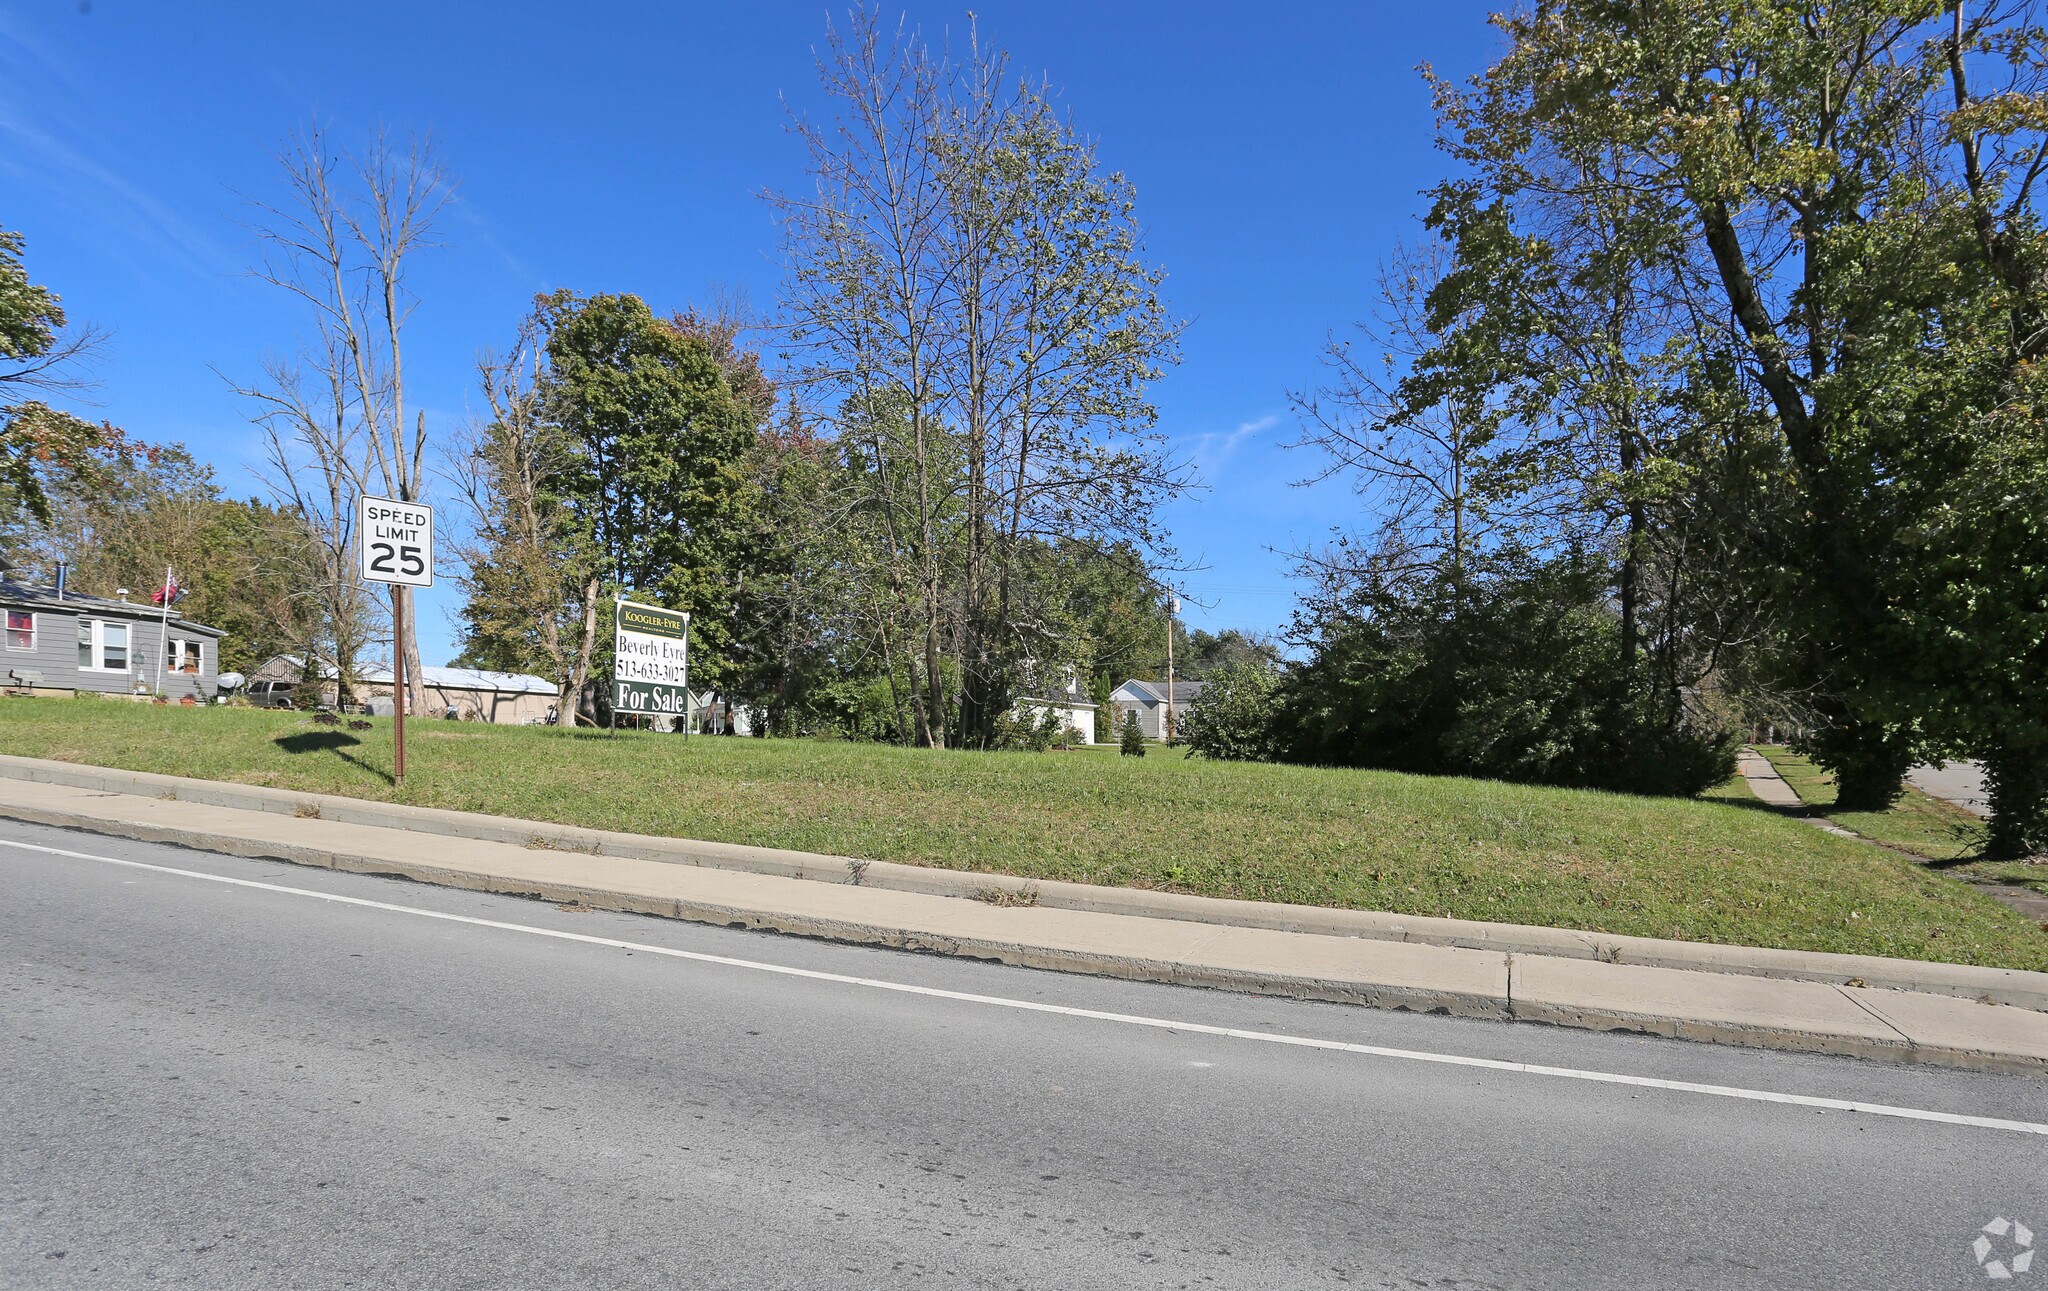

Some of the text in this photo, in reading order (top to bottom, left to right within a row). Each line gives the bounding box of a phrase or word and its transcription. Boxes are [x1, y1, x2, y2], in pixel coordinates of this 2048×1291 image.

[368, 507, 426, 526] SPEED
[376, 525, 419, 542] LIMIT
[370, 543, 425, 576] 25
[625, 611, 681, 630] KOOGLER-EYRE
[619, 635, 685, 663] Beverly Eyre
[617, 659, 685, 683] 513-633-3027
[617, 683, 684, 713] For Sale
